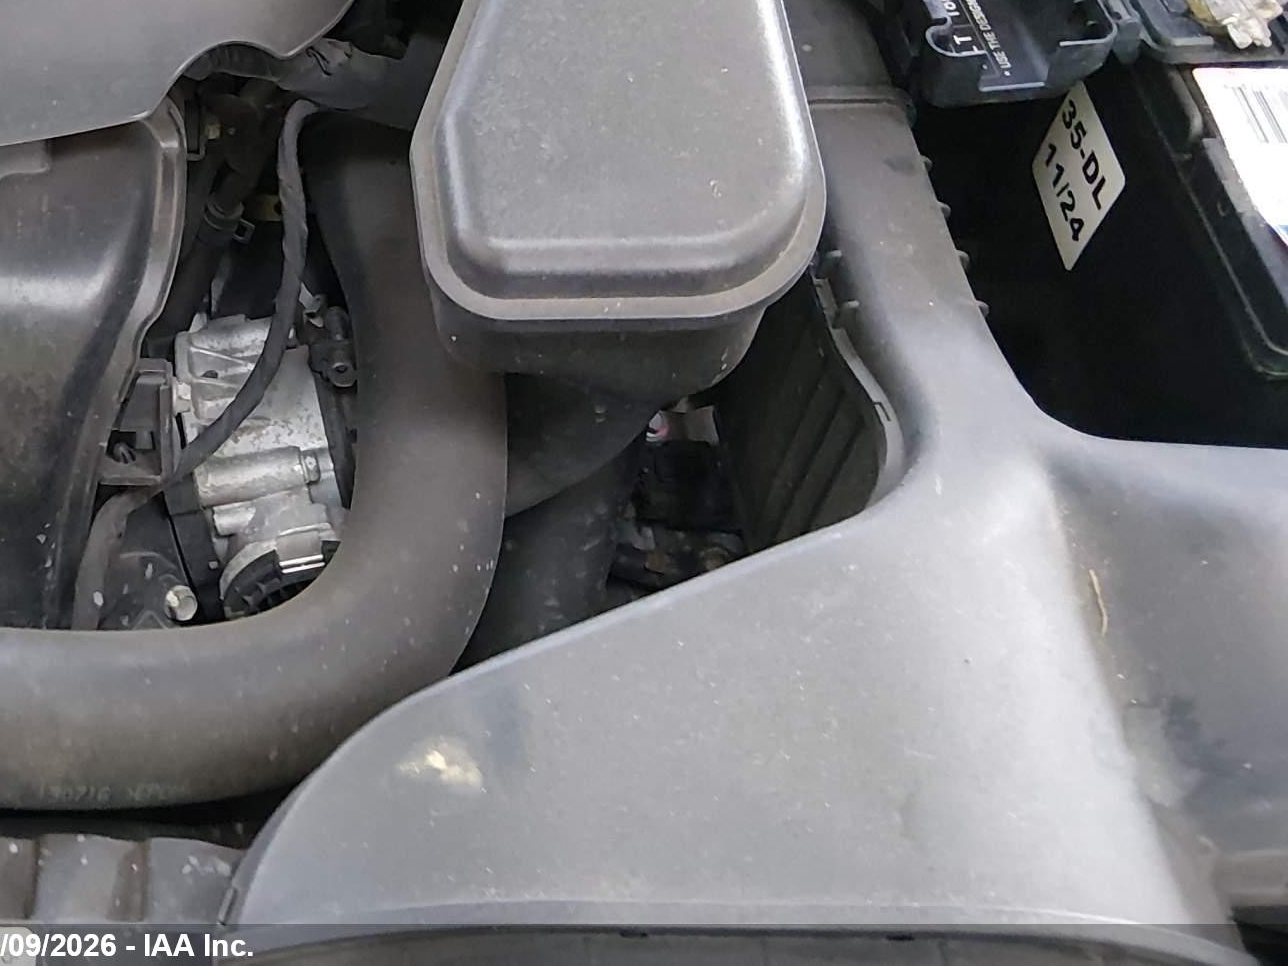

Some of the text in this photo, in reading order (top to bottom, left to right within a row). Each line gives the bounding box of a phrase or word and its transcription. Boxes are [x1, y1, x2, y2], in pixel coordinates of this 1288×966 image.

[983, 31, 1000, 50] THE
[993, 50, 1011, 69] USE
[1062, 99, 1106, 211] 35-DL
[1045, 143, 1084, 242] 11/24
